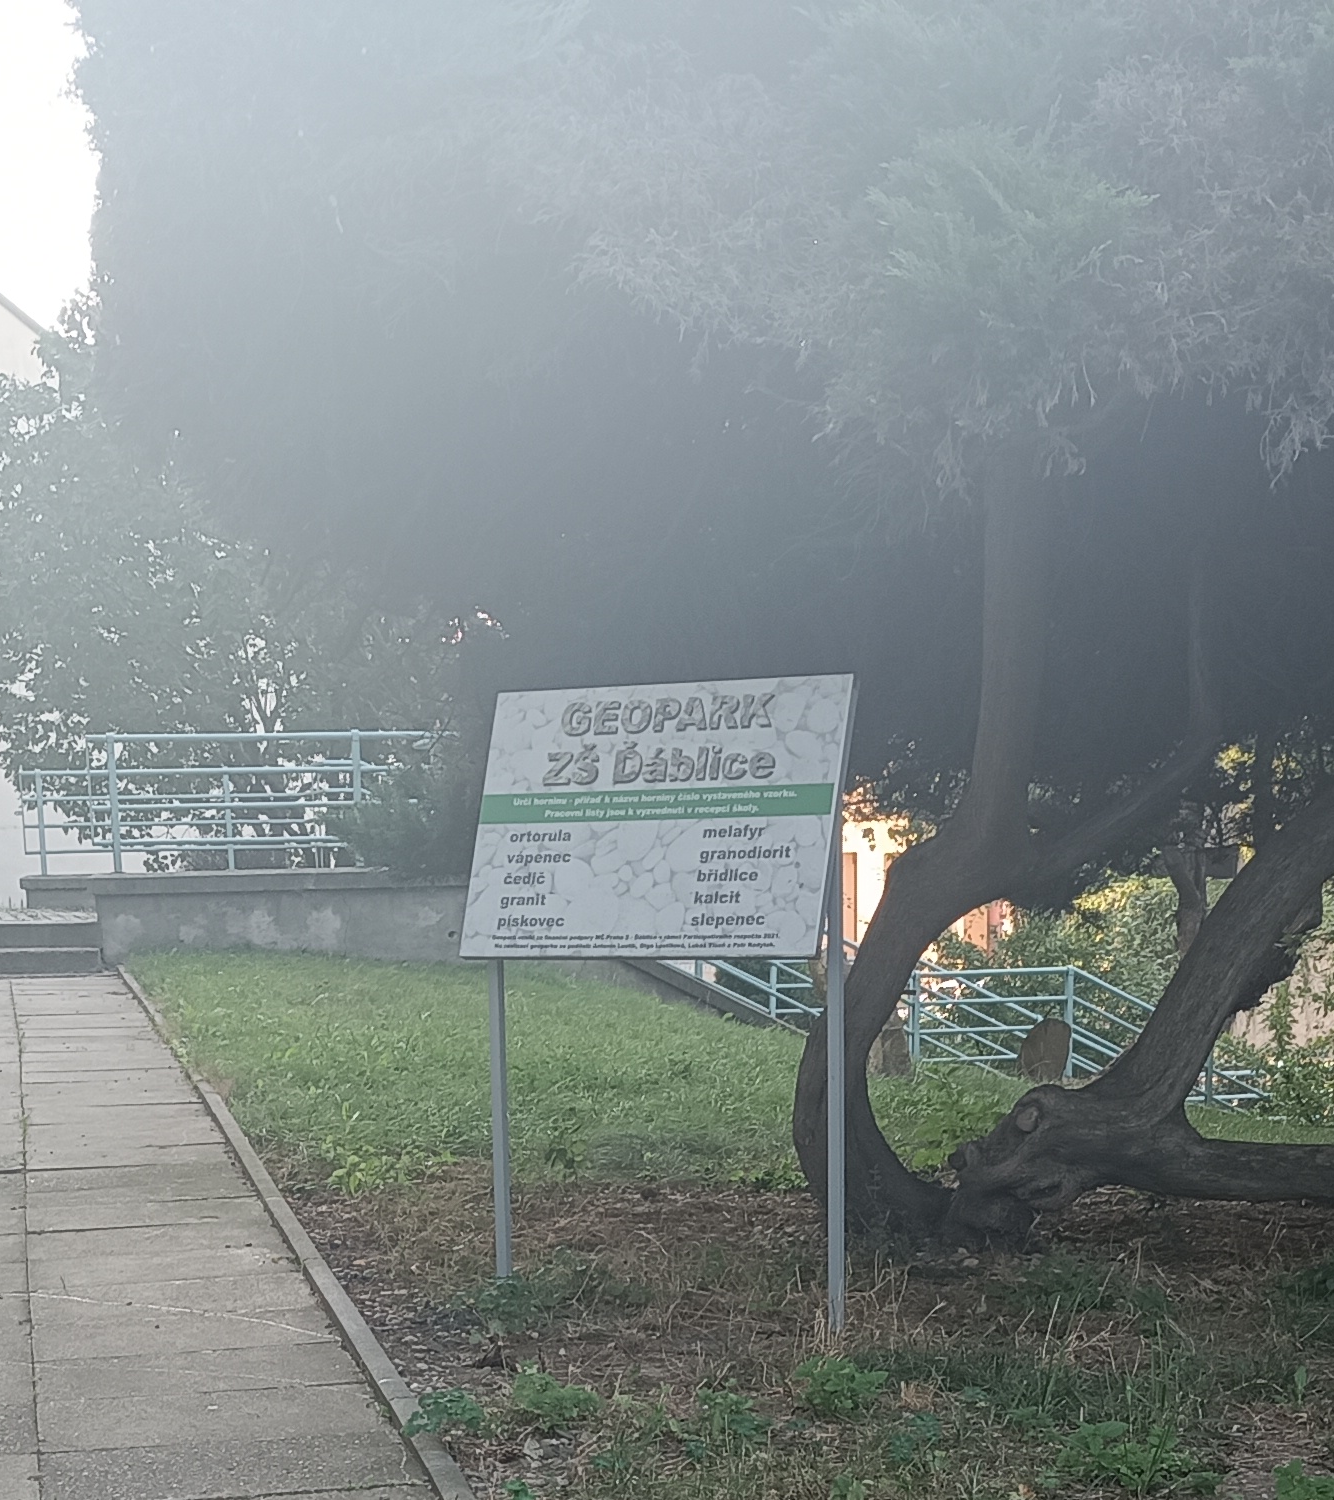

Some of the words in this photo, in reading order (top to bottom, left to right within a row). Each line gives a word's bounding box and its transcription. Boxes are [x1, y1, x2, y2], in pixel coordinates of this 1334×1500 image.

[562, 693, 776, 736] GEOPARK
[542, 744, 600, 787] ZŠ
[613, 741, 776, 786] Ďáblice
[533, 797, 567, 805] horninu
[604, 795, 610, 803] k
[612, 795, 639, 803] názvu
[641, 792, 675, 803] horniny
[678, 791, 700, 801] číslo
[702, 790, 761, 802] vystaveného
[763, 789, 797, 798] vzorku.
[544, 809, 583, 817] Pracovní
[586, 808, 604, 818] listy
[605, 808, 625, 817] jsou
[628, 807, 633, 816] k
[636, 805, 685, 818] vyzvednutí
[695, 804, 730, 815] recepci
[510, 829, 571, 843] ortorula
[703, 824, 765, 840] melafyr
[507, 849, 571, 866] vápenec
[700, 845, 791, 862] granodiorit
[503, 871, 545, 886] čedič
[697, 868, 758, 883] břidlice
[500, 894, 546, 908] granit
[694, 891, 741, 905] kalcit
[497, 914, 565, 930] pískovec
[691, 912, 765, 928] slepenec
